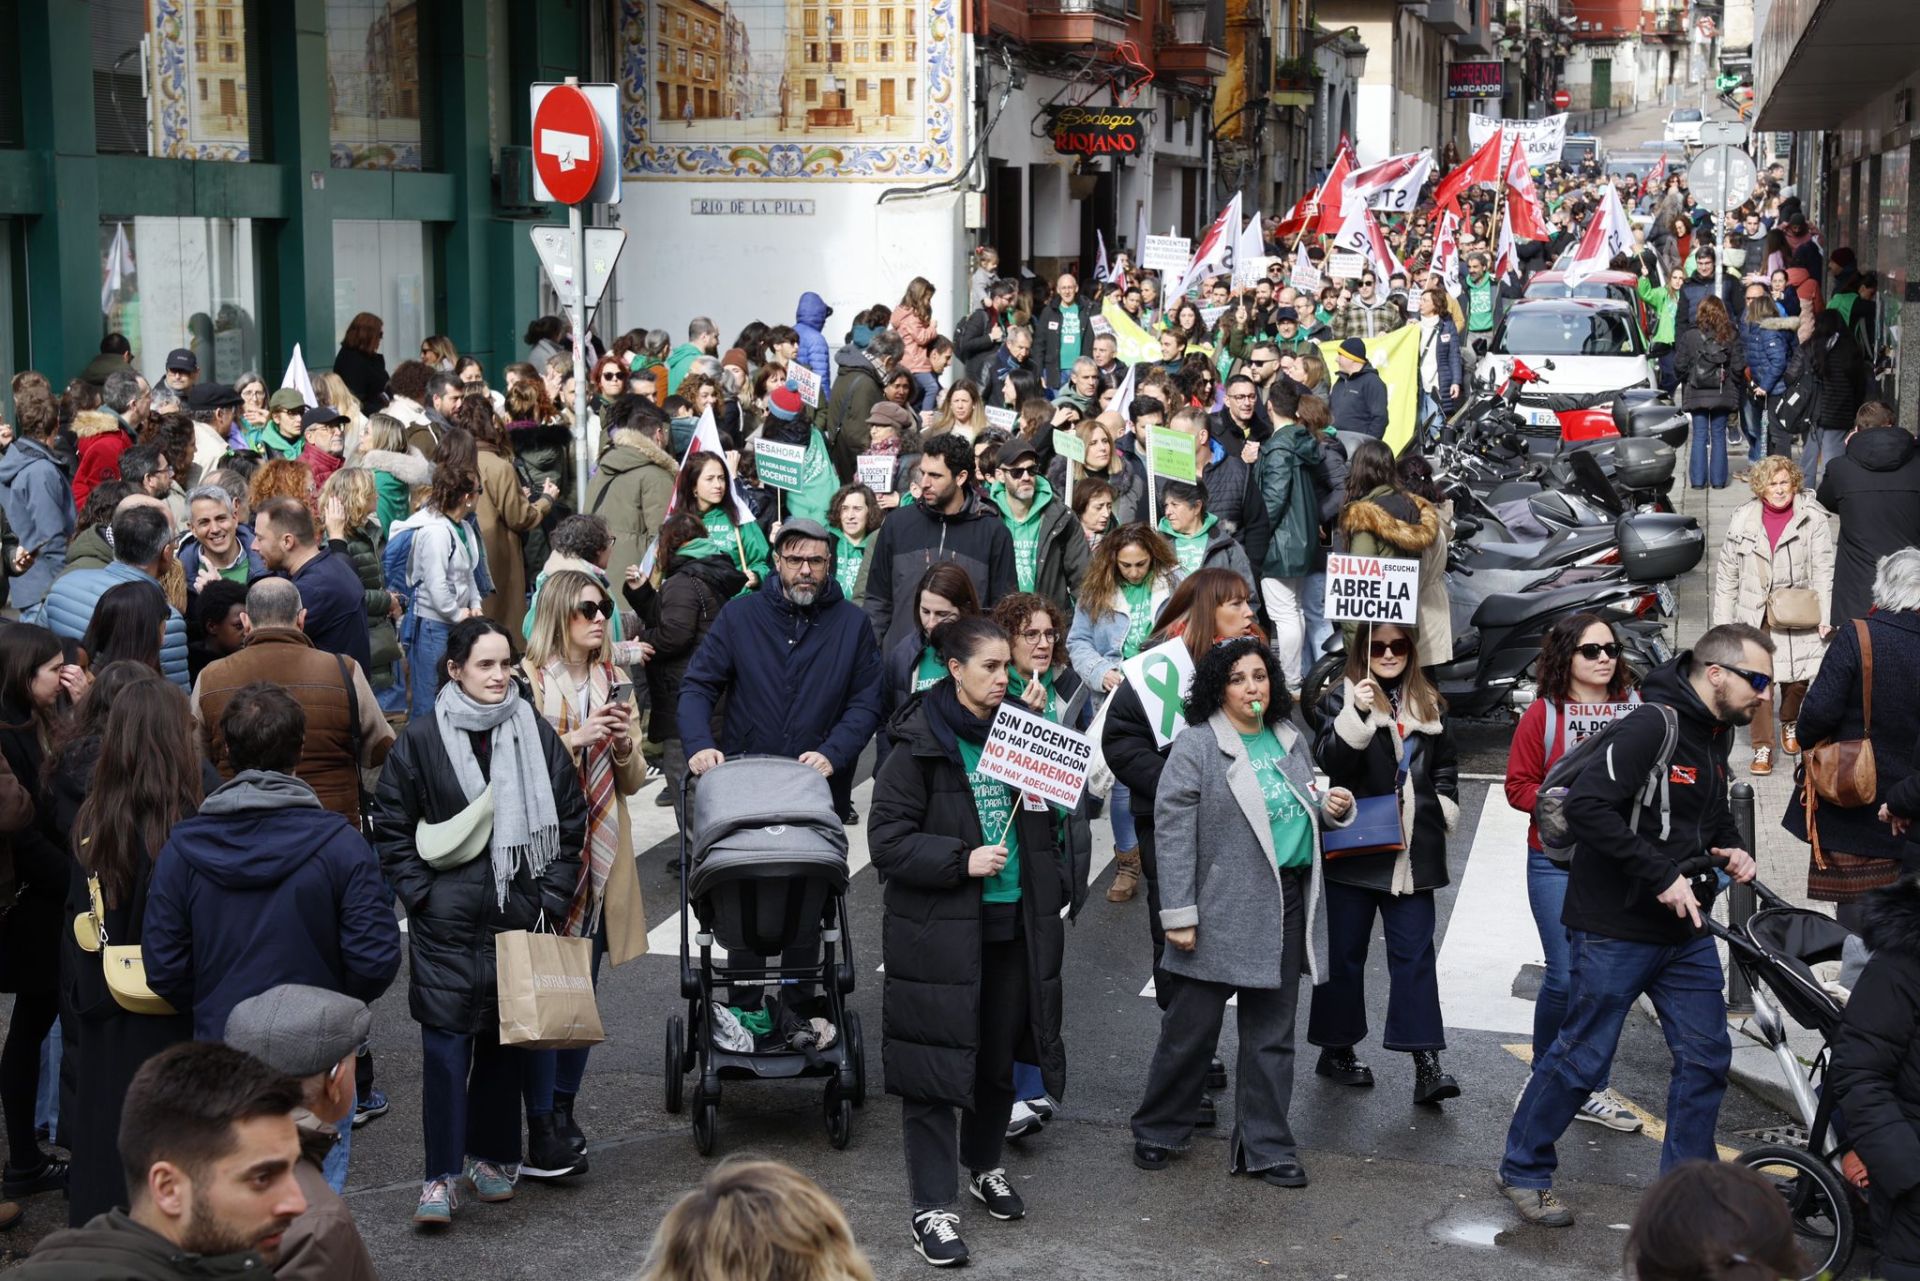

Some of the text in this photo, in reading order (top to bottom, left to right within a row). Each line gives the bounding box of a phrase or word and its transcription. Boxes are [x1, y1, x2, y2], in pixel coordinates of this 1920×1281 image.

[1450, 63, 1502, 84] IMPRENTA
[1450, 84, 1501, 93] MARCADOR
[1060, 107, 1135, 130] Bodega
[1055, 132, 1136, 155] RIOJANO
[1529, 142, 1559, 153] RURAL
[701, 201, 804, 214] RIO DE LA PILA
[756, 442, 802, 459] #ESAHORA
[760, 469, 798, 485] DOCENTES
[1330, 578, 1410, 600] ABRE LA
[1336, 598, 1402, 619] HUCHA
[997, 711, 1092, 759] SIN DOCENTES
[1569, 721, 1586, 731] AL
[991, 727, 1087, 773] NO HAY EDUCACIÓN
[980, 759, 989, 768] SI
[990, 763, 1003, 774] NO
[1004, 768, 1022, 781] HAY
[985, 741, 1005, 758] NO
[1006, 750, 1083, 789] PARAREMOS
